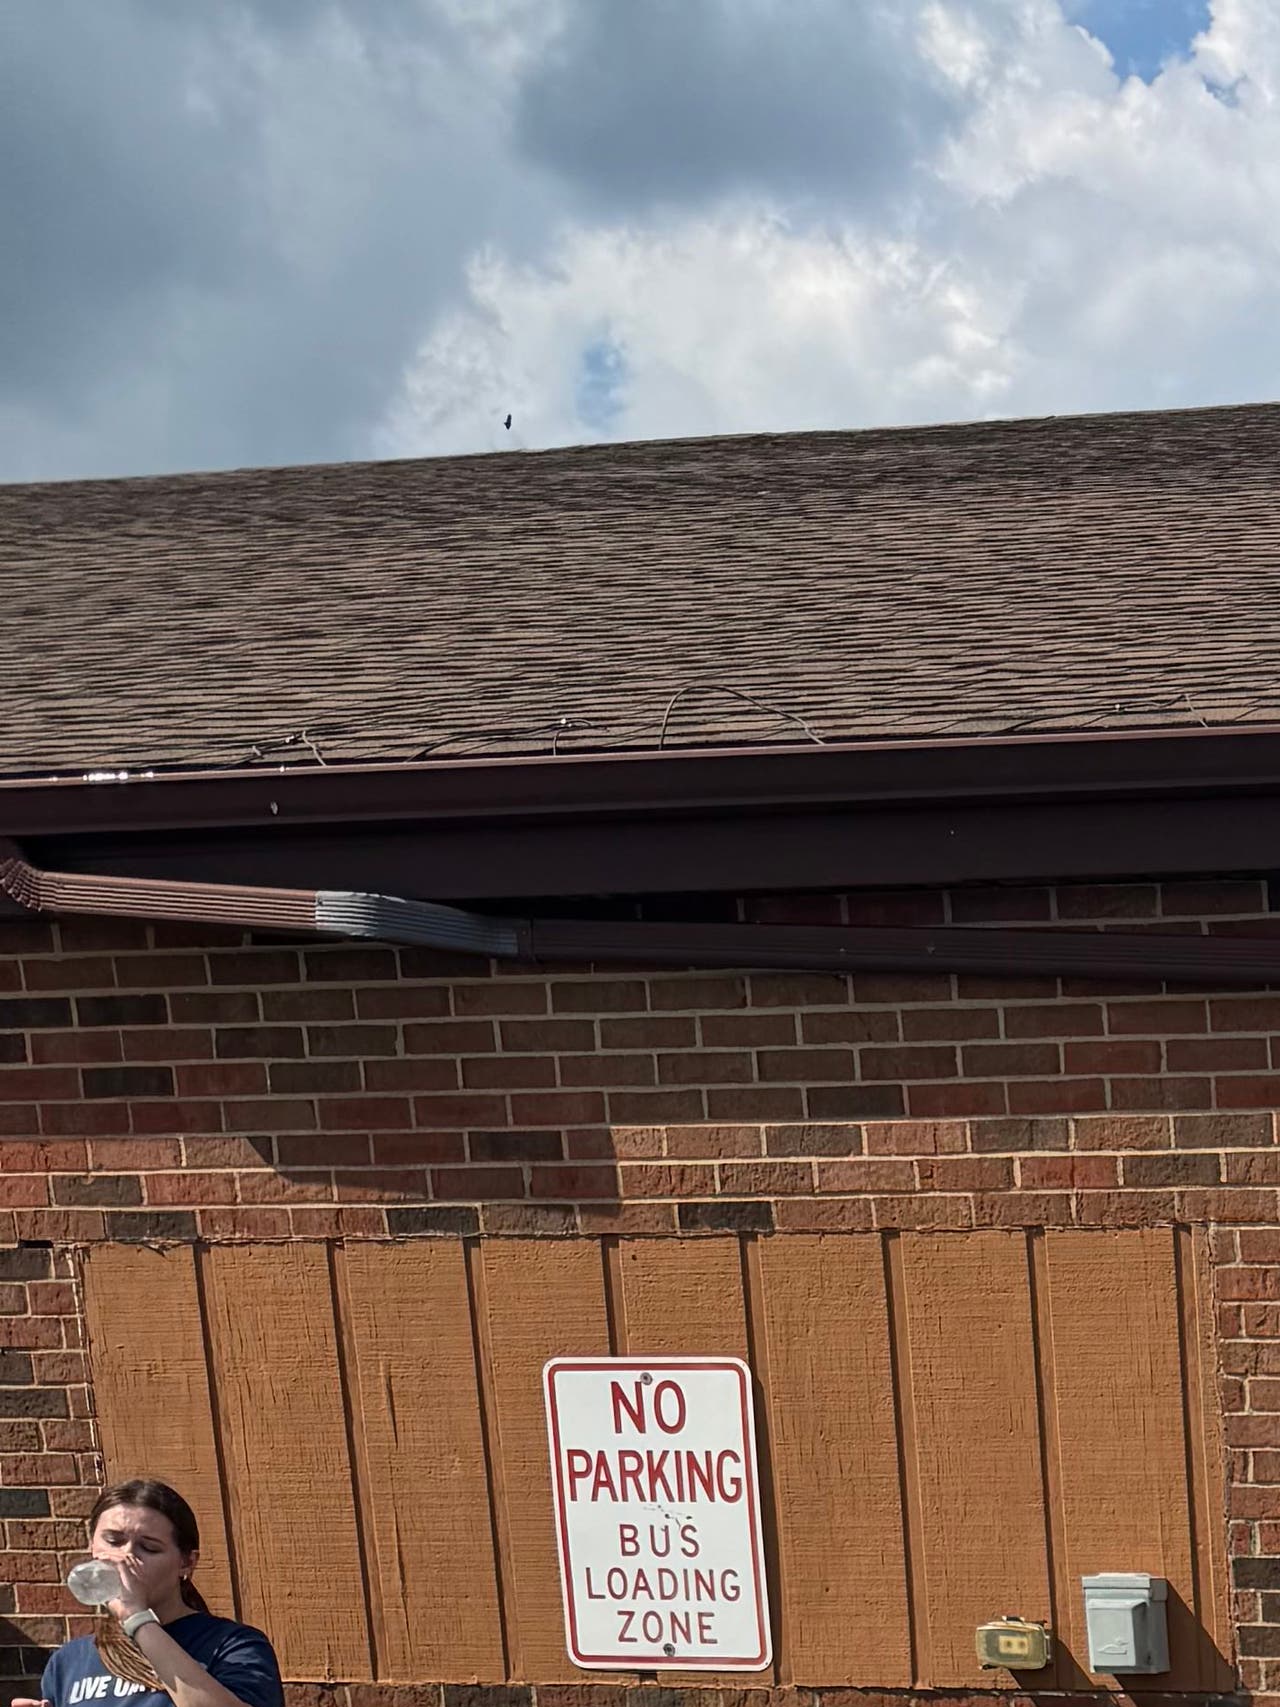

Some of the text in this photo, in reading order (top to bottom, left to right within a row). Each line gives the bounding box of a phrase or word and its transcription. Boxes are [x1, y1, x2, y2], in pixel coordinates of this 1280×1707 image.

[610, 1380, 687, 1434] NO
[566, 1449, 743, 1503] PARKING
[619, 1523, 700, 1558] BUS
[585, 1567, 741, 1601] LOADING
[616, 1611, 718, 1644] ZONE
[69, 1676, 112, 1704] LIVE
